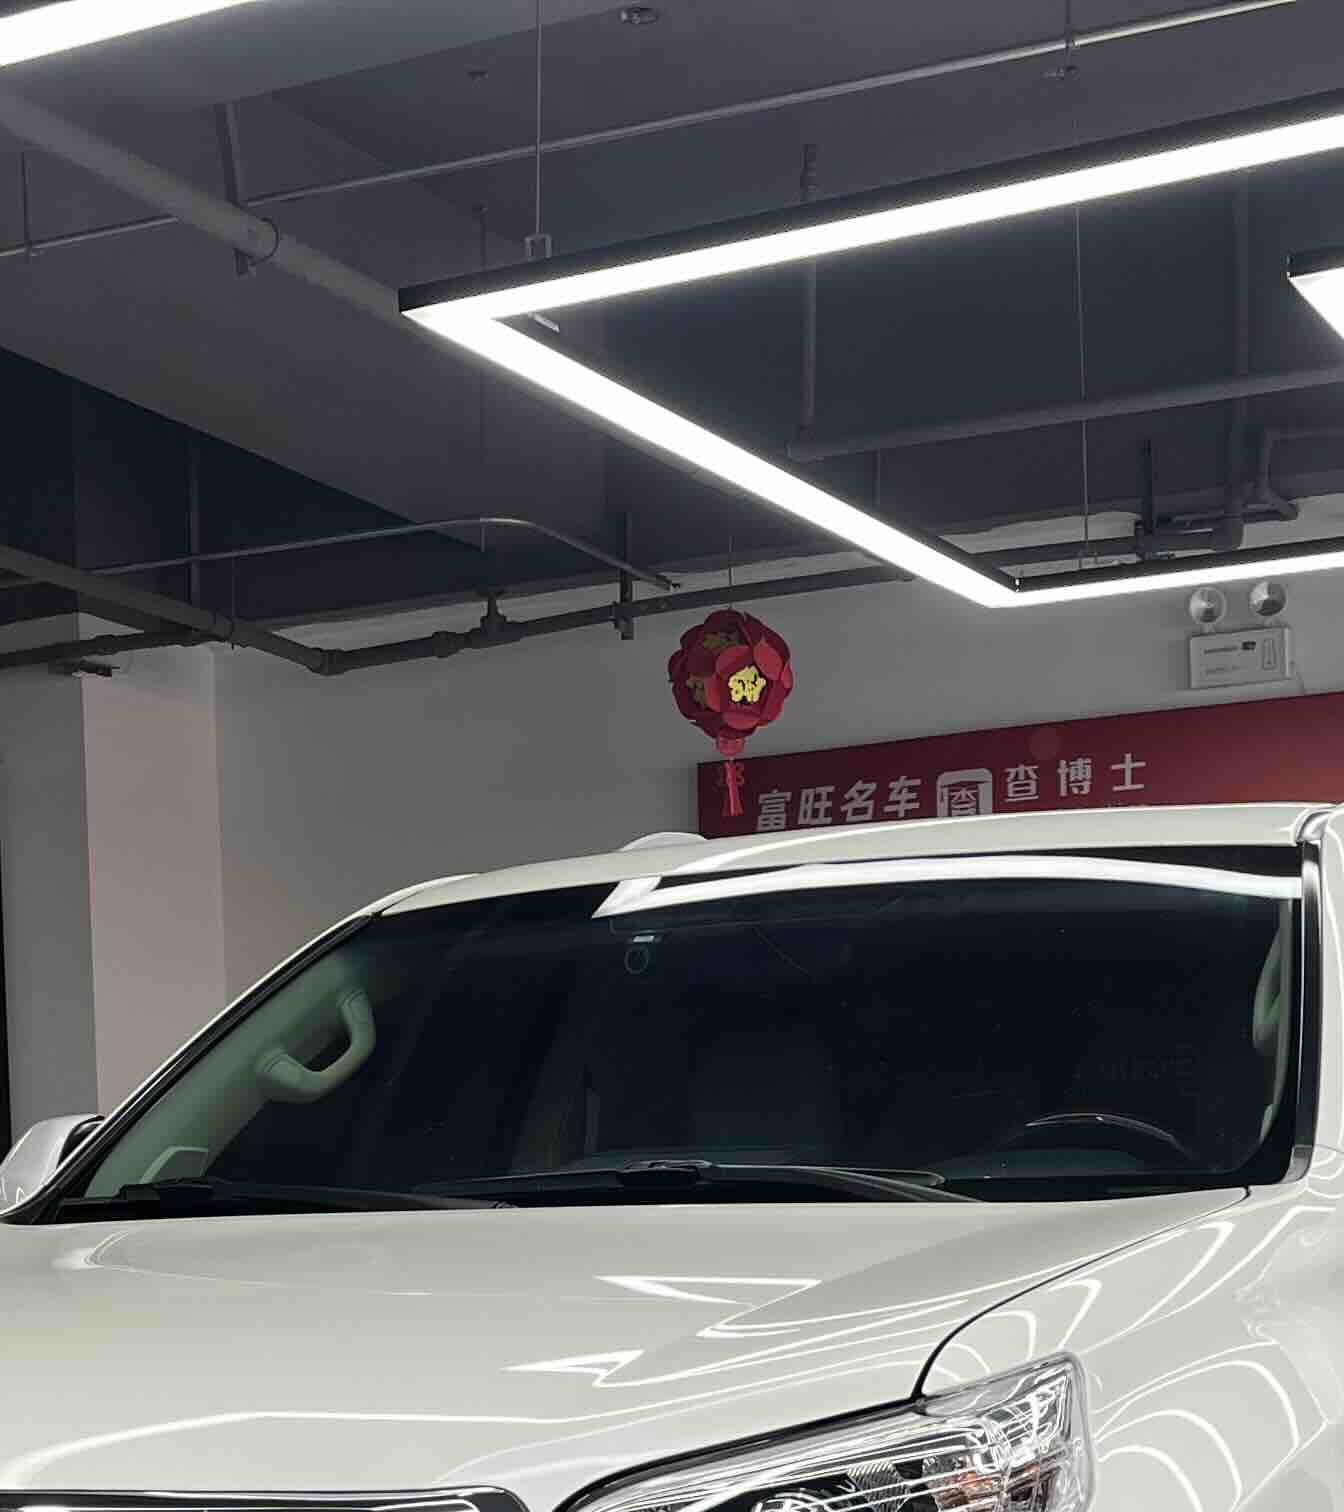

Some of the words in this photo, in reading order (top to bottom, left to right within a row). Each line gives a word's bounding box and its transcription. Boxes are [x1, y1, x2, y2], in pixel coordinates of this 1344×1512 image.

[757, 776, 920, 830] 富旺名车
[1004, 752, 1147, 802] 查博士
